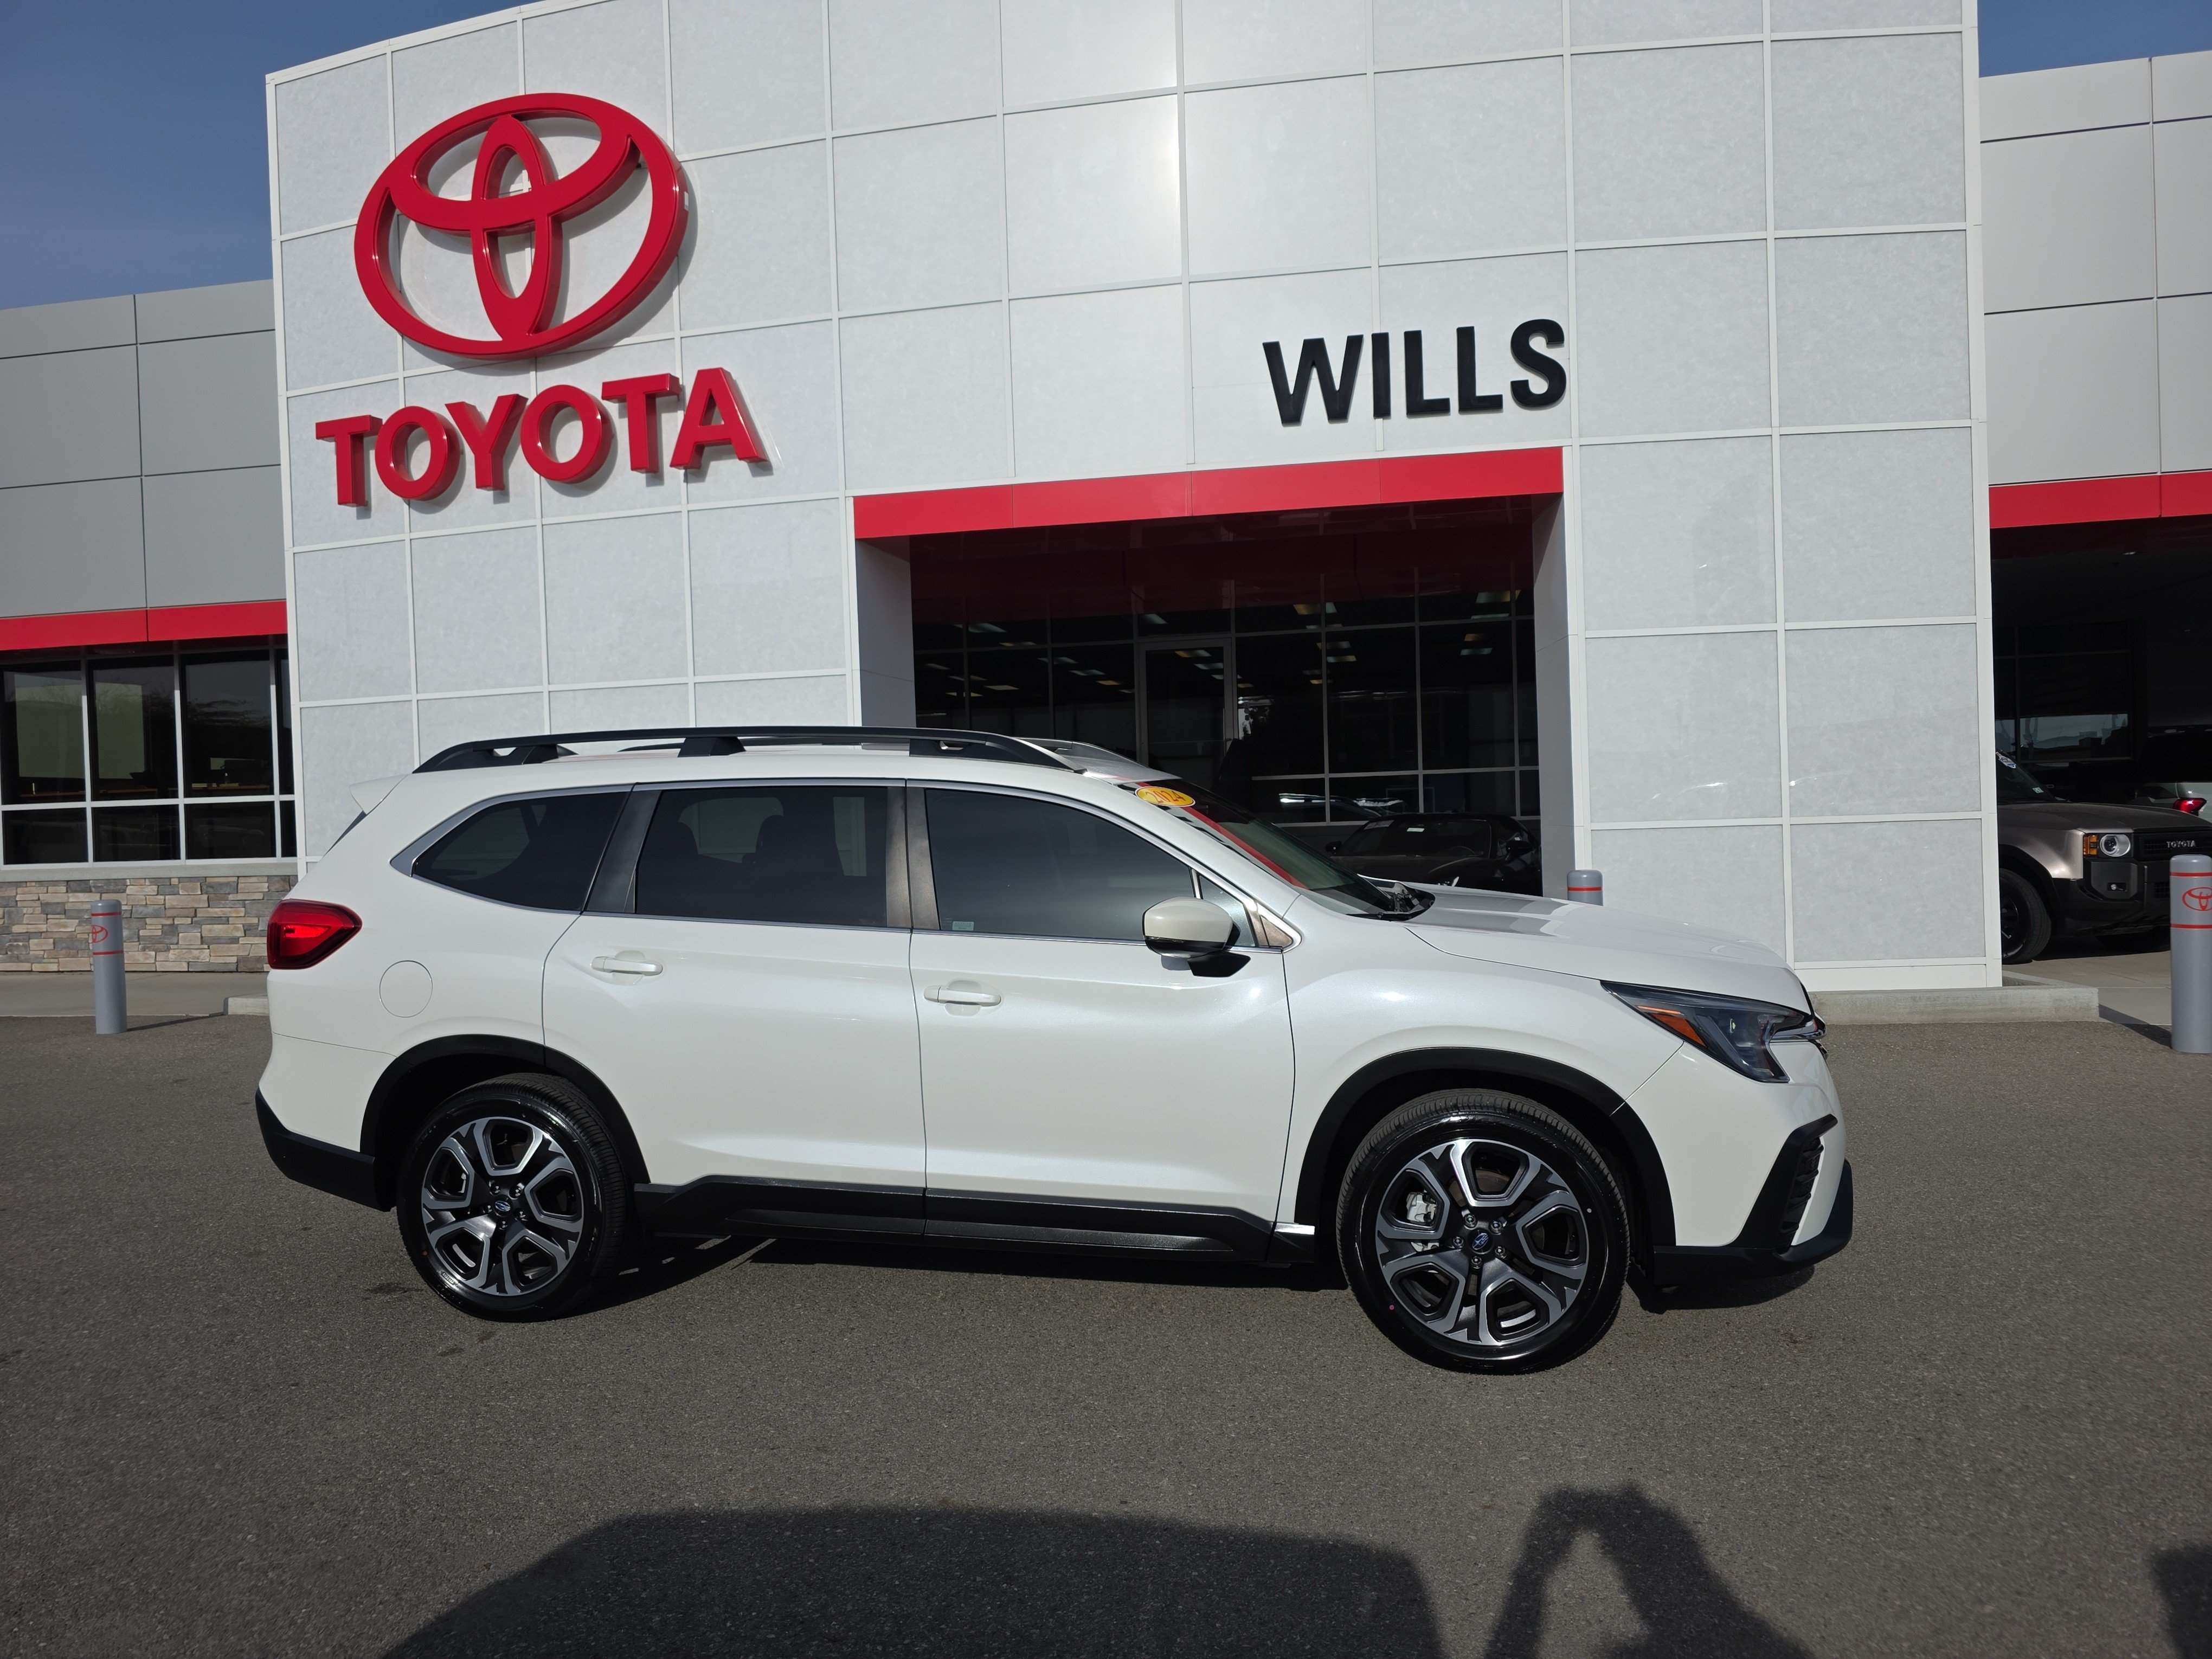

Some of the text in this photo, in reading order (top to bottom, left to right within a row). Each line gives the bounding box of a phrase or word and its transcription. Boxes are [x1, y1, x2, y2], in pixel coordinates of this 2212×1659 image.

[1262, 318, 1567, 425] WILLS
[316, 367, 768, 506] TOYOTA
[1145, 790, 1187, 803] 2024
[2166, 840, 2196, 848] TOYOTA
